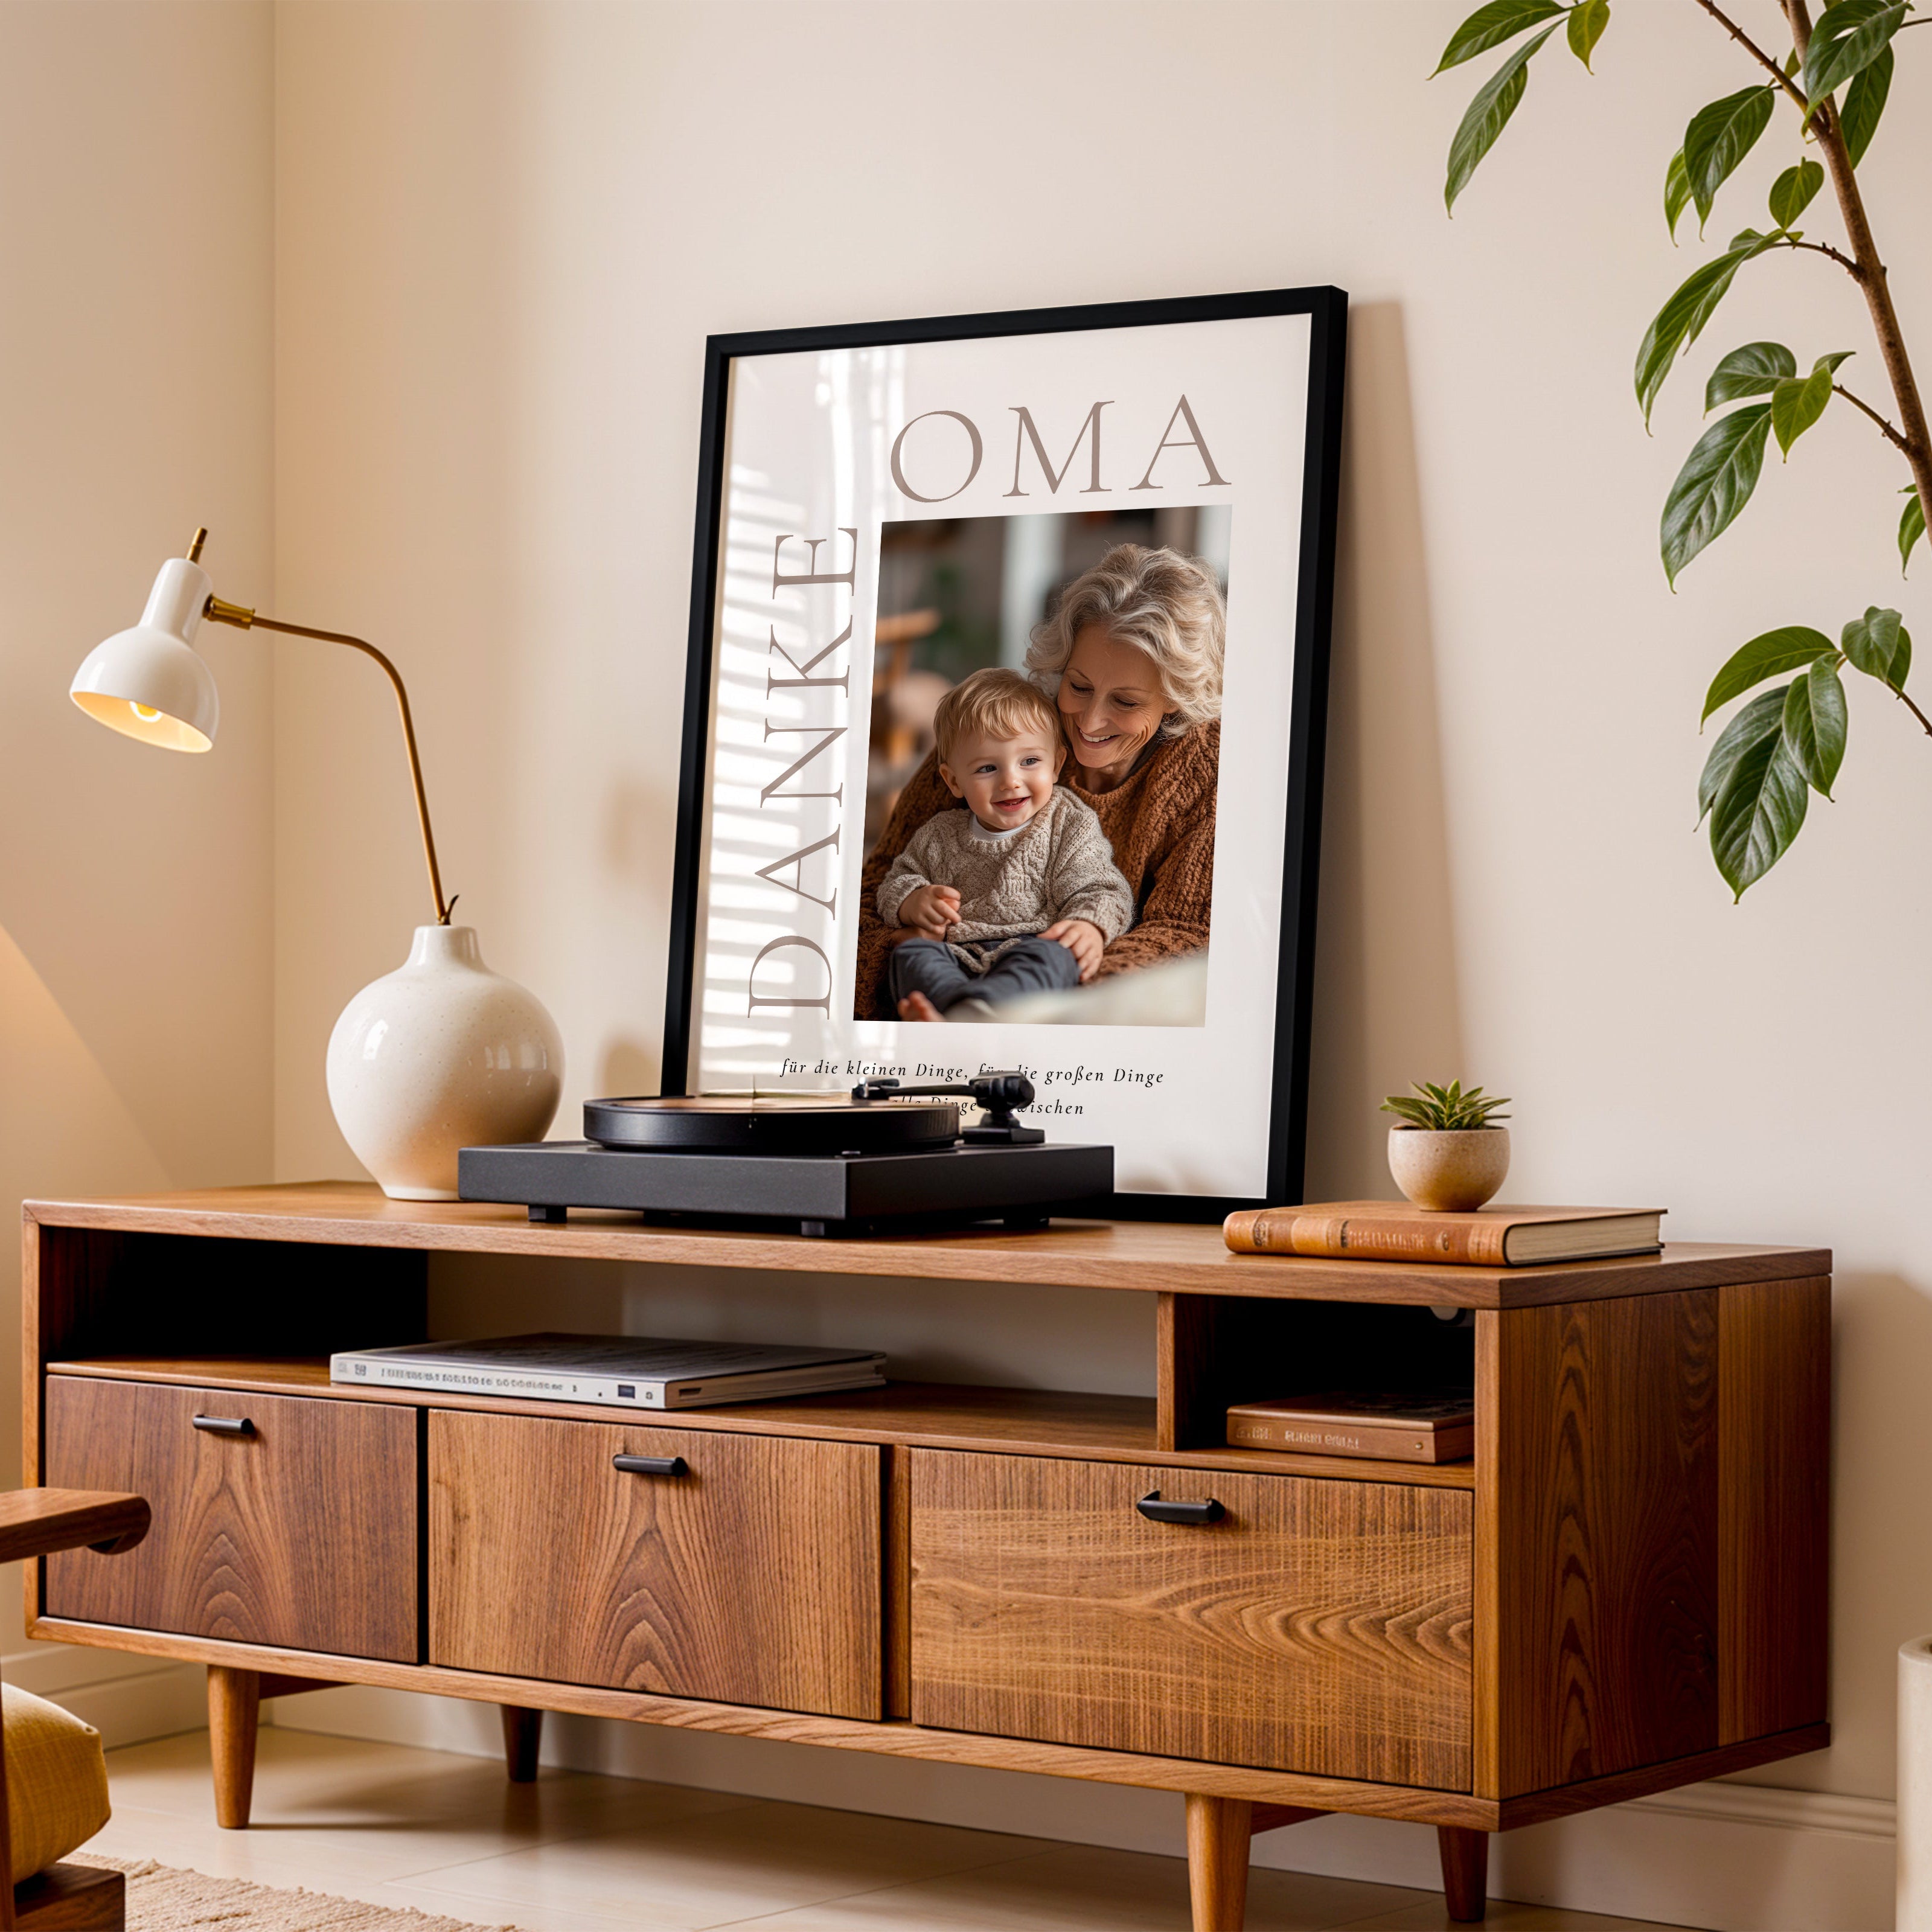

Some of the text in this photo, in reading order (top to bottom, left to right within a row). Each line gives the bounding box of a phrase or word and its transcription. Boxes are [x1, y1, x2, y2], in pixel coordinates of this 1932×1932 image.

[889, 394, 1232, 503] OMA
[747, 527, 858, 1020] DANKE
[779, 1058, 807, 1078] für
[814, 1059, 838, 1074] die
[846, 1060, 906, 1076] kleinen
[915, 1063, 968, 1083] Dinge,
[1044, 1065, 1104, 1086] großen
[1113, 1068, 1163, 1088] Dinge
